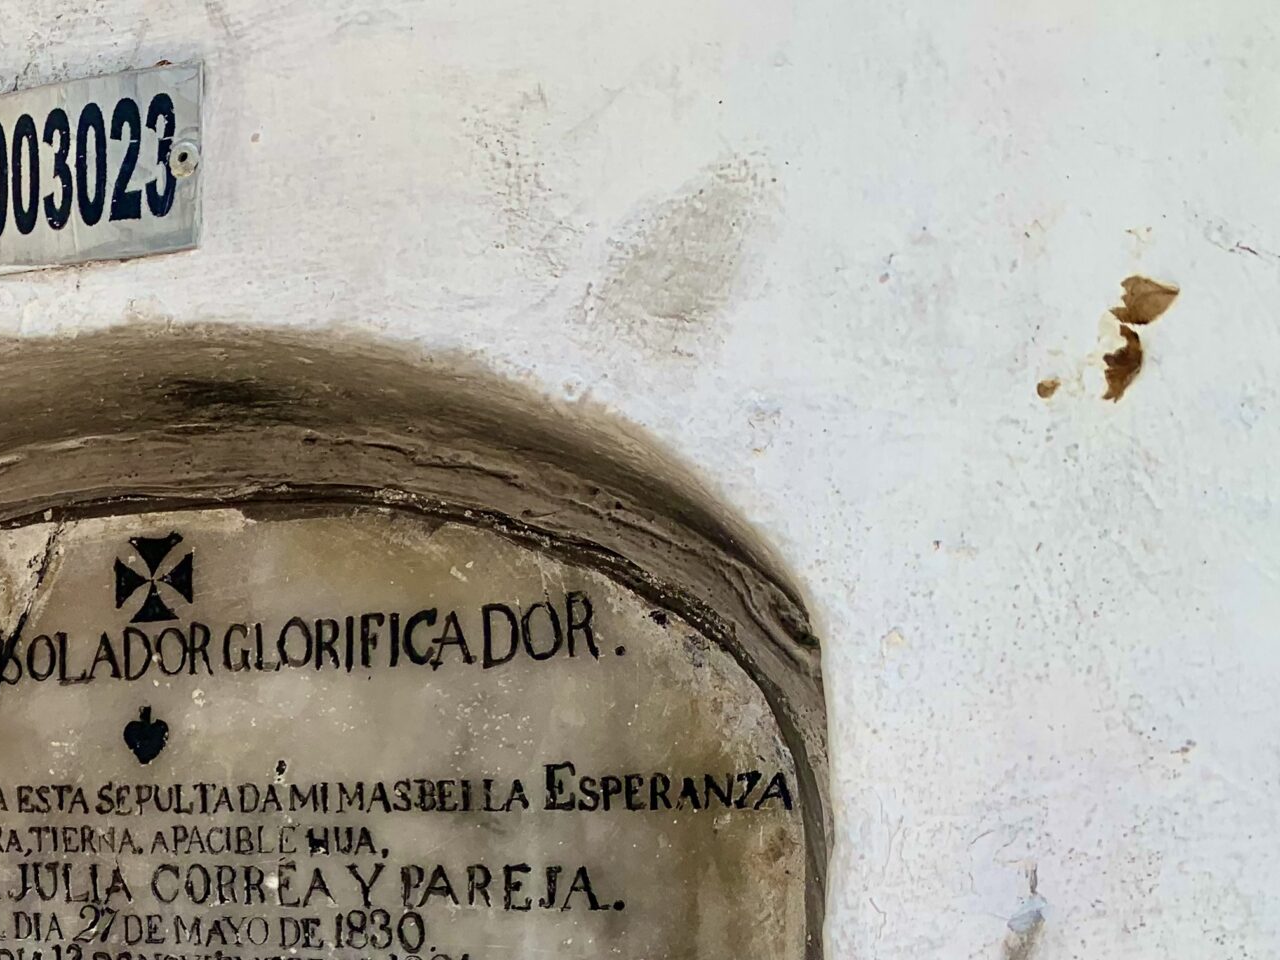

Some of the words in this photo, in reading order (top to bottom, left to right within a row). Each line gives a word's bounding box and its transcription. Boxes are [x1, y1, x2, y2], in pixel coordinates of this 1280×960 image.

[7, 859, 133, 905] JULIA
[150, 858, 337, 908] CORREA
[345, 862, 386, 910] Y
[400, 862, 626, 912] PAREJA.
[73, 904, 120, 943] 27
[122, 914, 166, 946] DE
[173, 914, 270, 948] MAYO
[278, 916, 325, 949] DE
